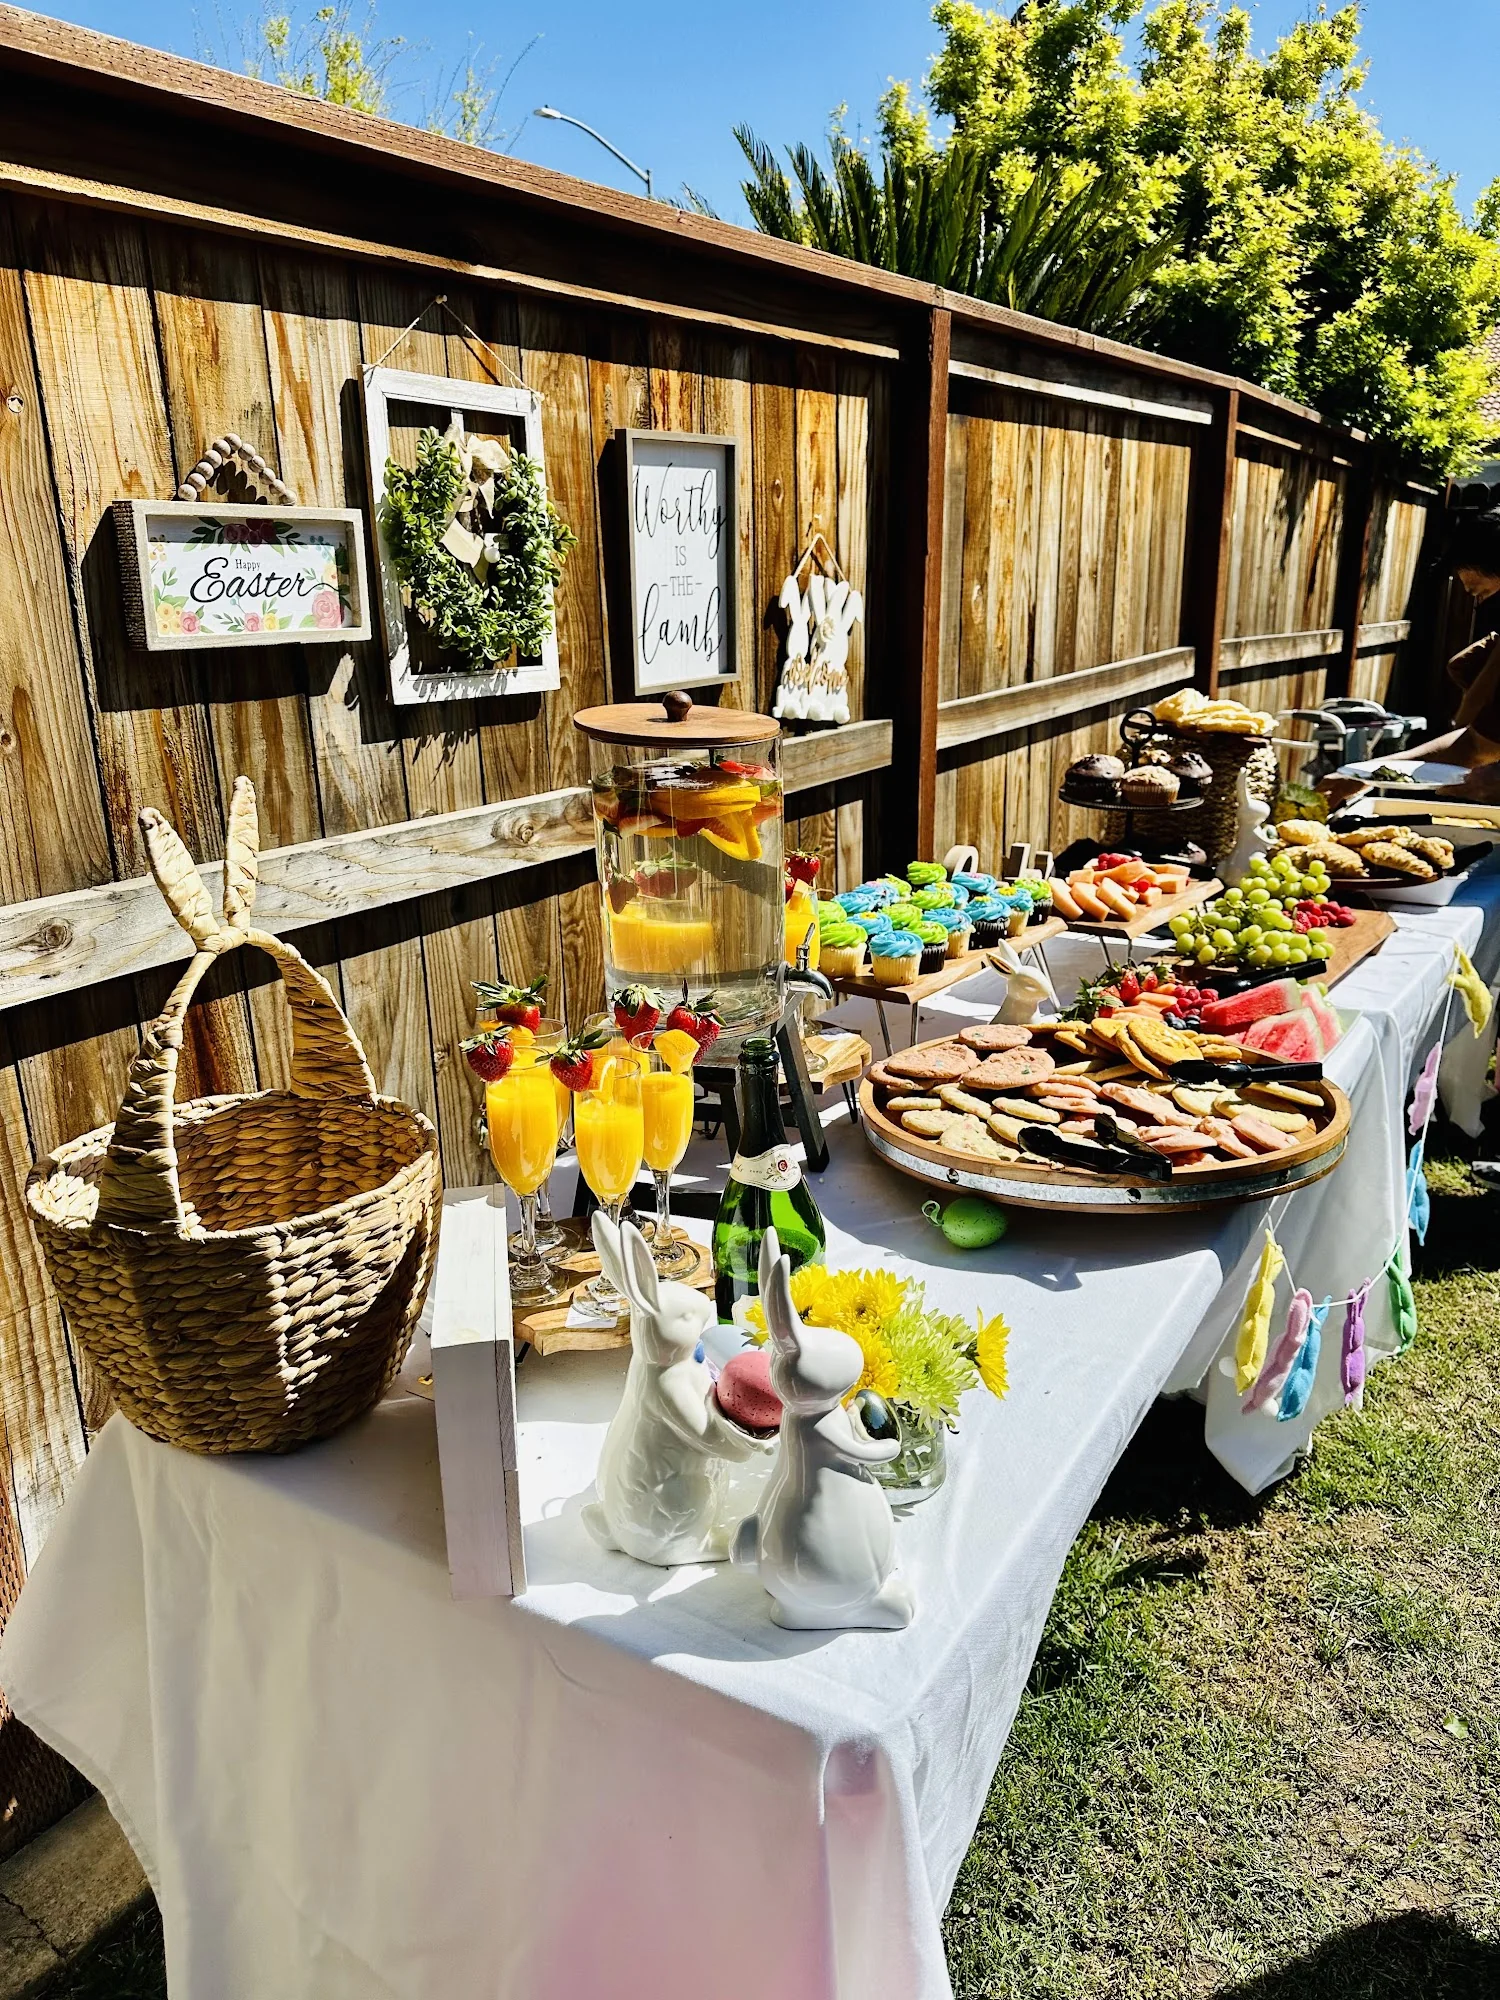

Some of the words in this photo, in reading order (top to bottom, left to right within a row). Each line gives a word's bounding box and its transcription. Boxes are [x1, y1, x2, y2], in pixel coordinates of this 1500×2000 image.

[633, 462, 726, 559] Worthy
[235, 559, 261, 571] Happy
[675, 545, 687, 566] IS
[190, 556, 339, 603] Easter
